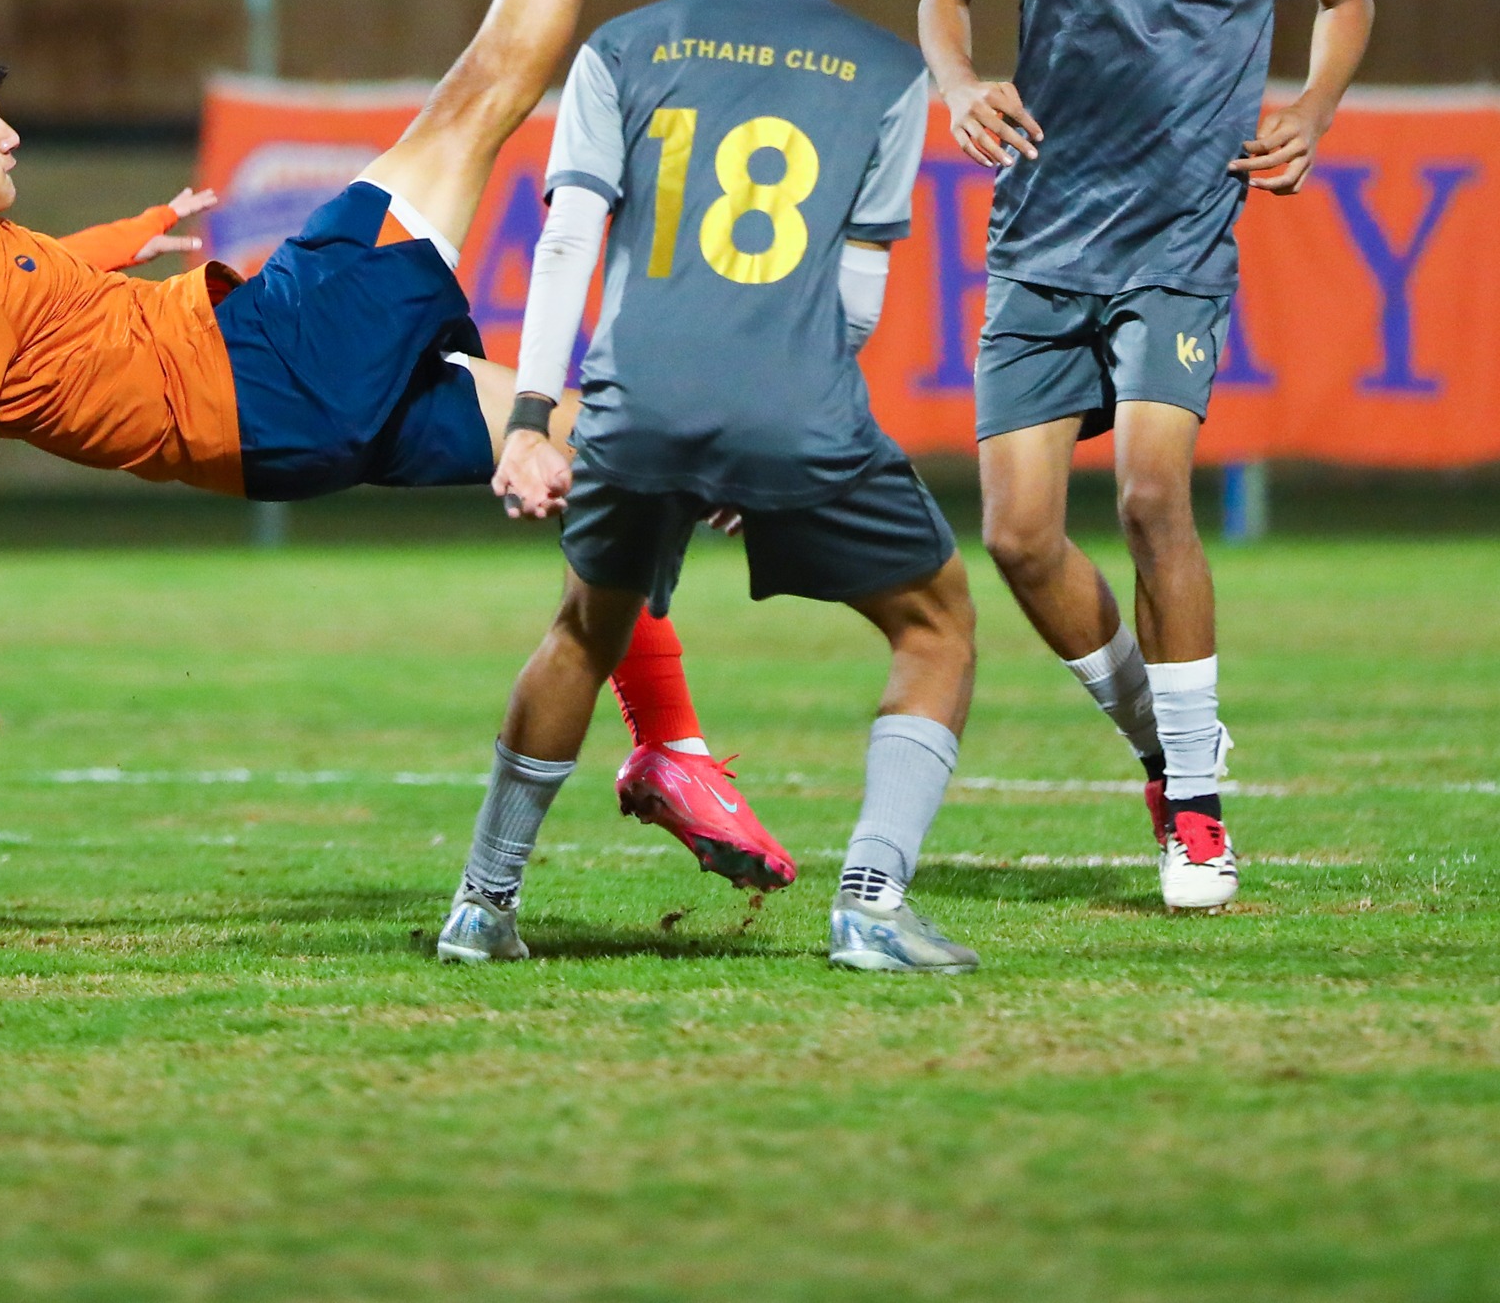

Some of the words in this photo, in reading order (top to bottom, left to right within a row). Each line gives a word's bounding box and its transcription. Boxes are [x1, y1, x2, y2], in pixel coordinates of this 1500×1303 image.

[652, 38, 774, 66] ALTHAHB
[785, 49, 857, 82] CLUB
[647, 108, 820, 284] 18
